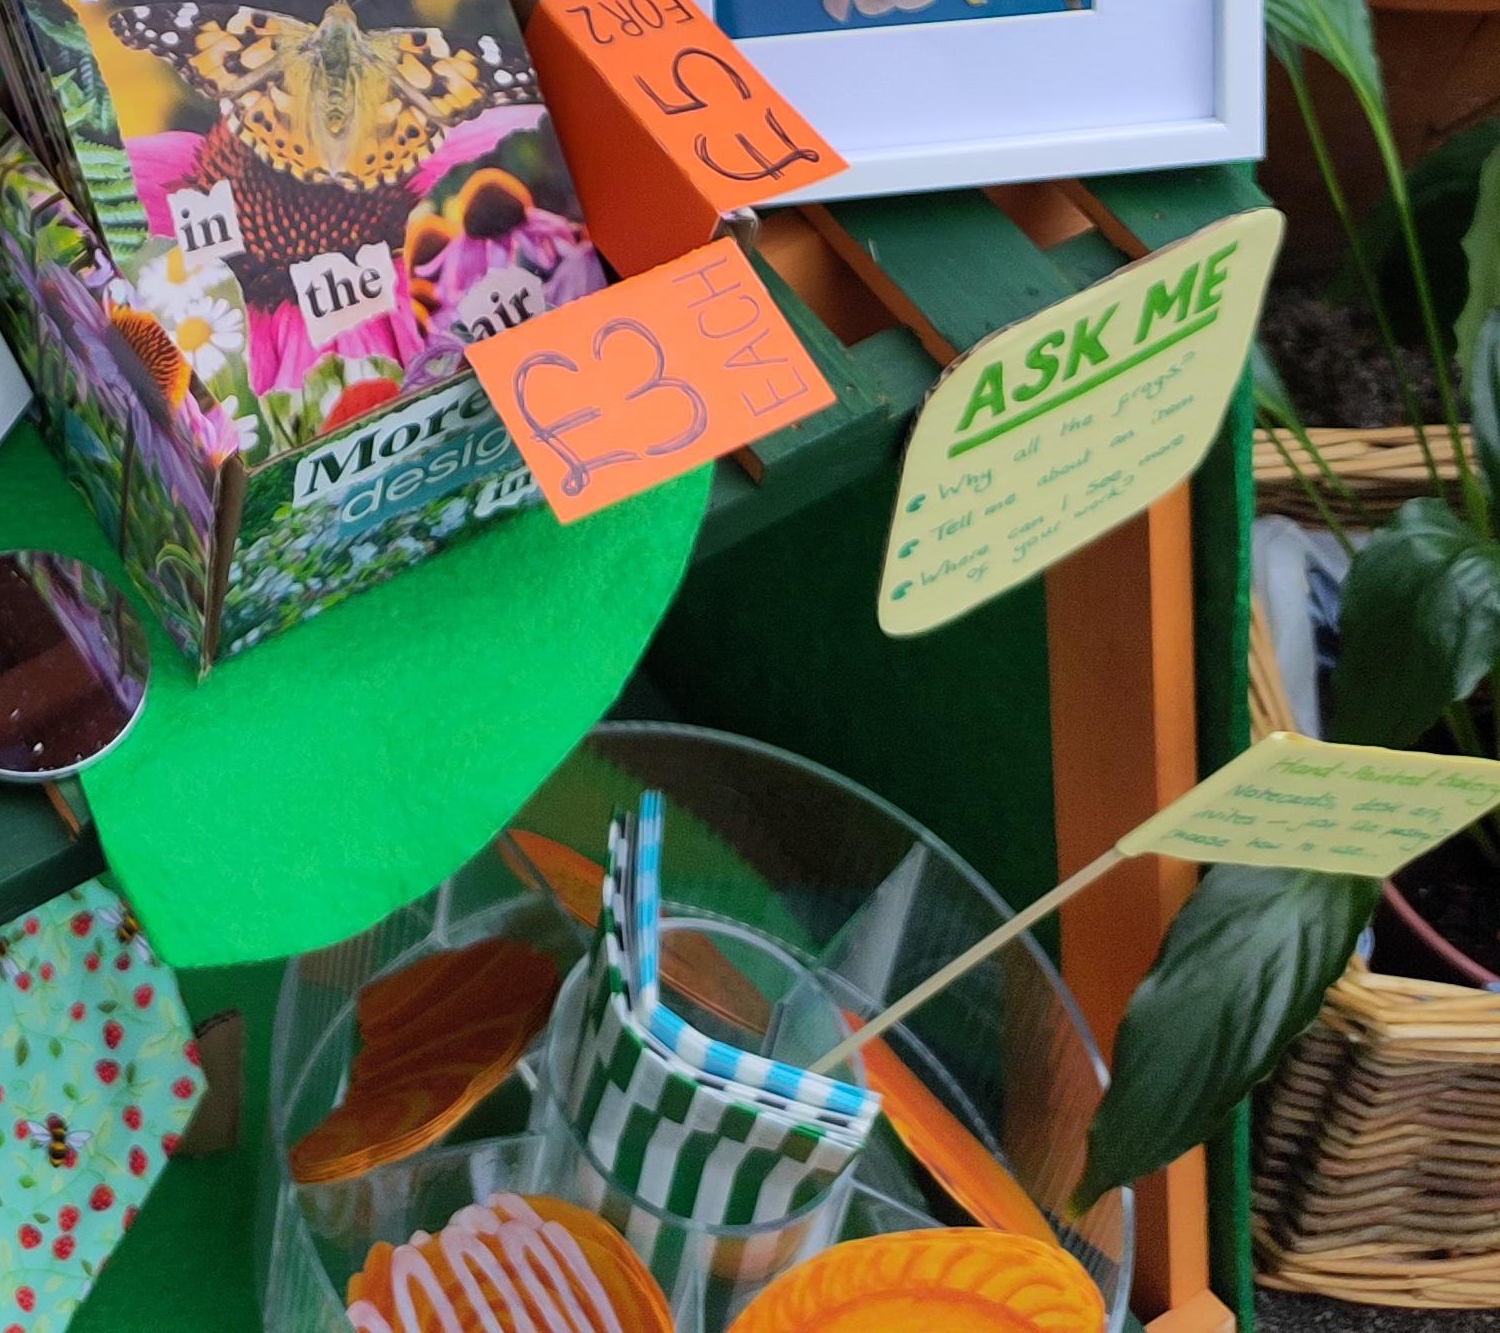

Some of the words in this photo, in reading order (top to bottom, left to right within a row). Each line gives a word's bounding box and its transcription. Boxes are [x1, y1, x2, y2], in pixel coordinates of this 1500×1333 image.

[633, 47, 820, 181] £5
[180, 207, 231, 253] in
[304, 267, 383, 318] the
[671, 256, 808, 417] EACH
[954, 302, 1120, 433] ASK
[1133, 241, 1238, 345] ME
[303, 386, 492, 497] More
[514, 317, 708, 496] £3
[938, 468, 993, 501] Why
[1013, 436, 1041, 462] all
[1060, 414, 1093, 436] the
[930, 510, 973, 542] Tell
[1037, 448, 1092, 487] about
